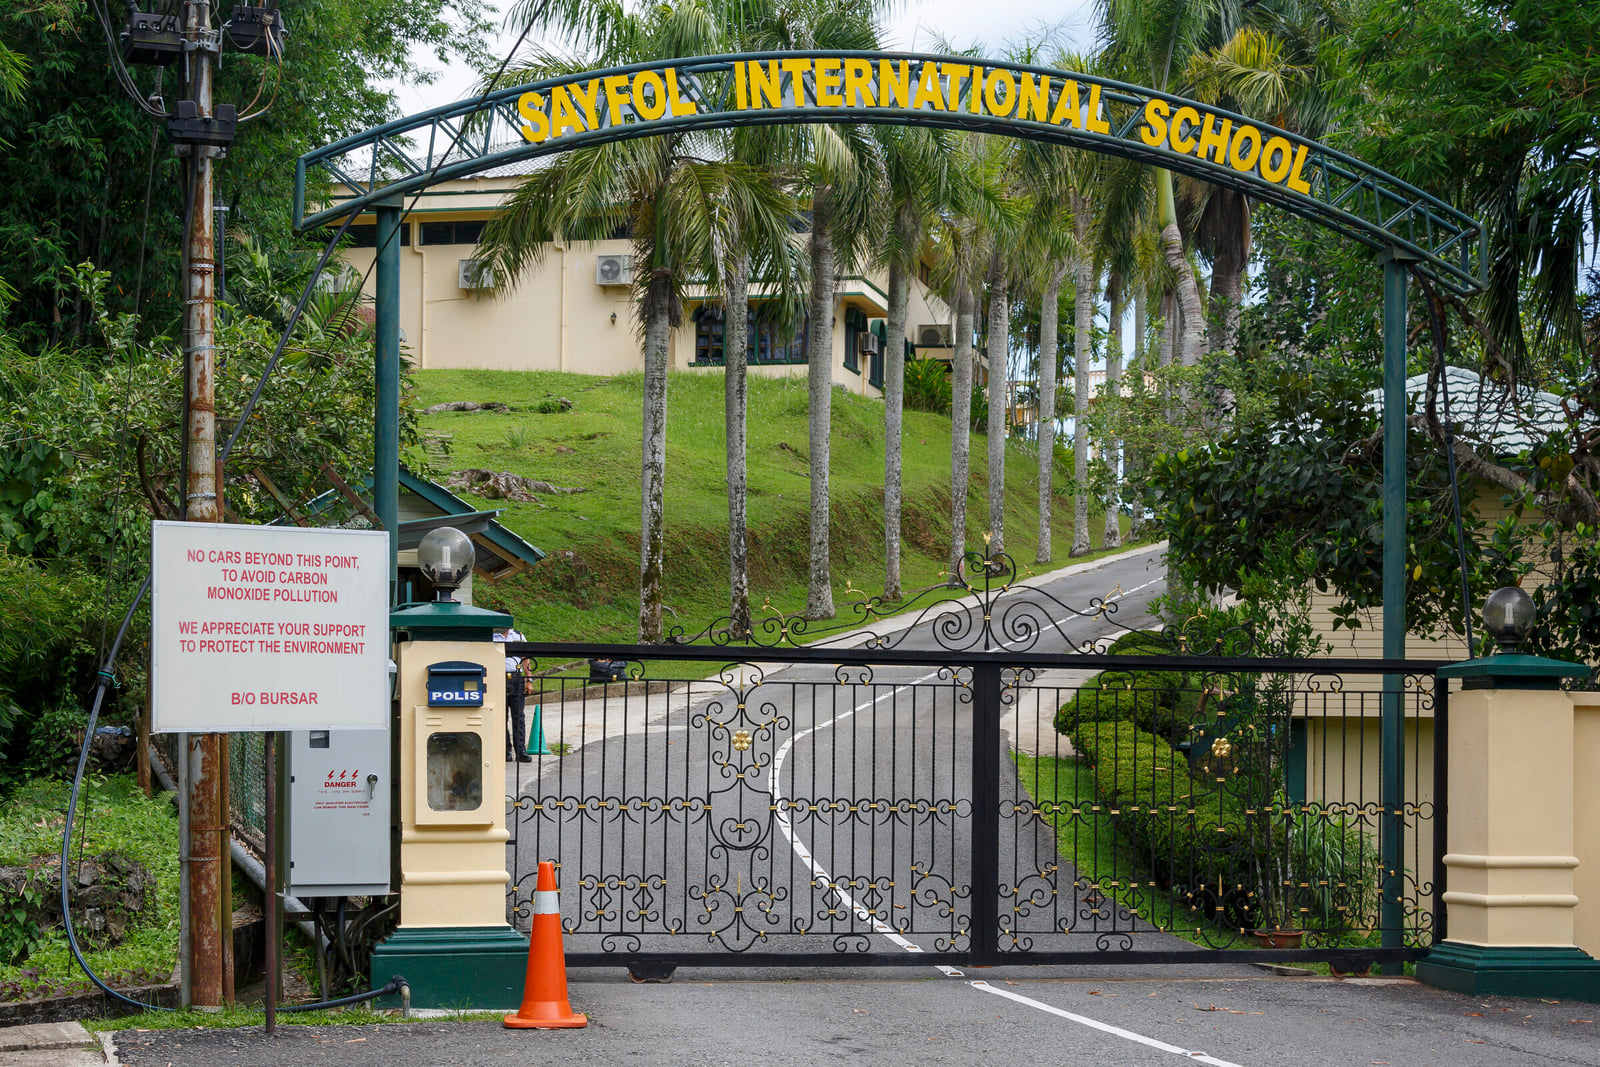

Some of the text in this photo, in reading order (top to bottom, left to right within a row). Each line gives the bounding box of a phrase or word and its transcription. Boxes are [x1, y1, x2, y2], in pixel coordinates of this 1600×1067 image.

[518, 58, 1311, 195] SAYFOL INTERNATIONAL SCHOOL
[188, 550, 359, 569] NO CARS BEYOND THIS POINT,
[222, 569, 327, 585] TO AVOID CARBON
[208, 586, 337, 602] MONOXIDE POLLUTION
[179, 621, 366, 637] WE APPRECIATE YOUR SUPPORT
[180, 640, 365, 655] TO PROTECT THE ENVIRONMENT
[232, 692, 318, 704] B/O BURSAR
[431, 691, 480, 701] POLIS
